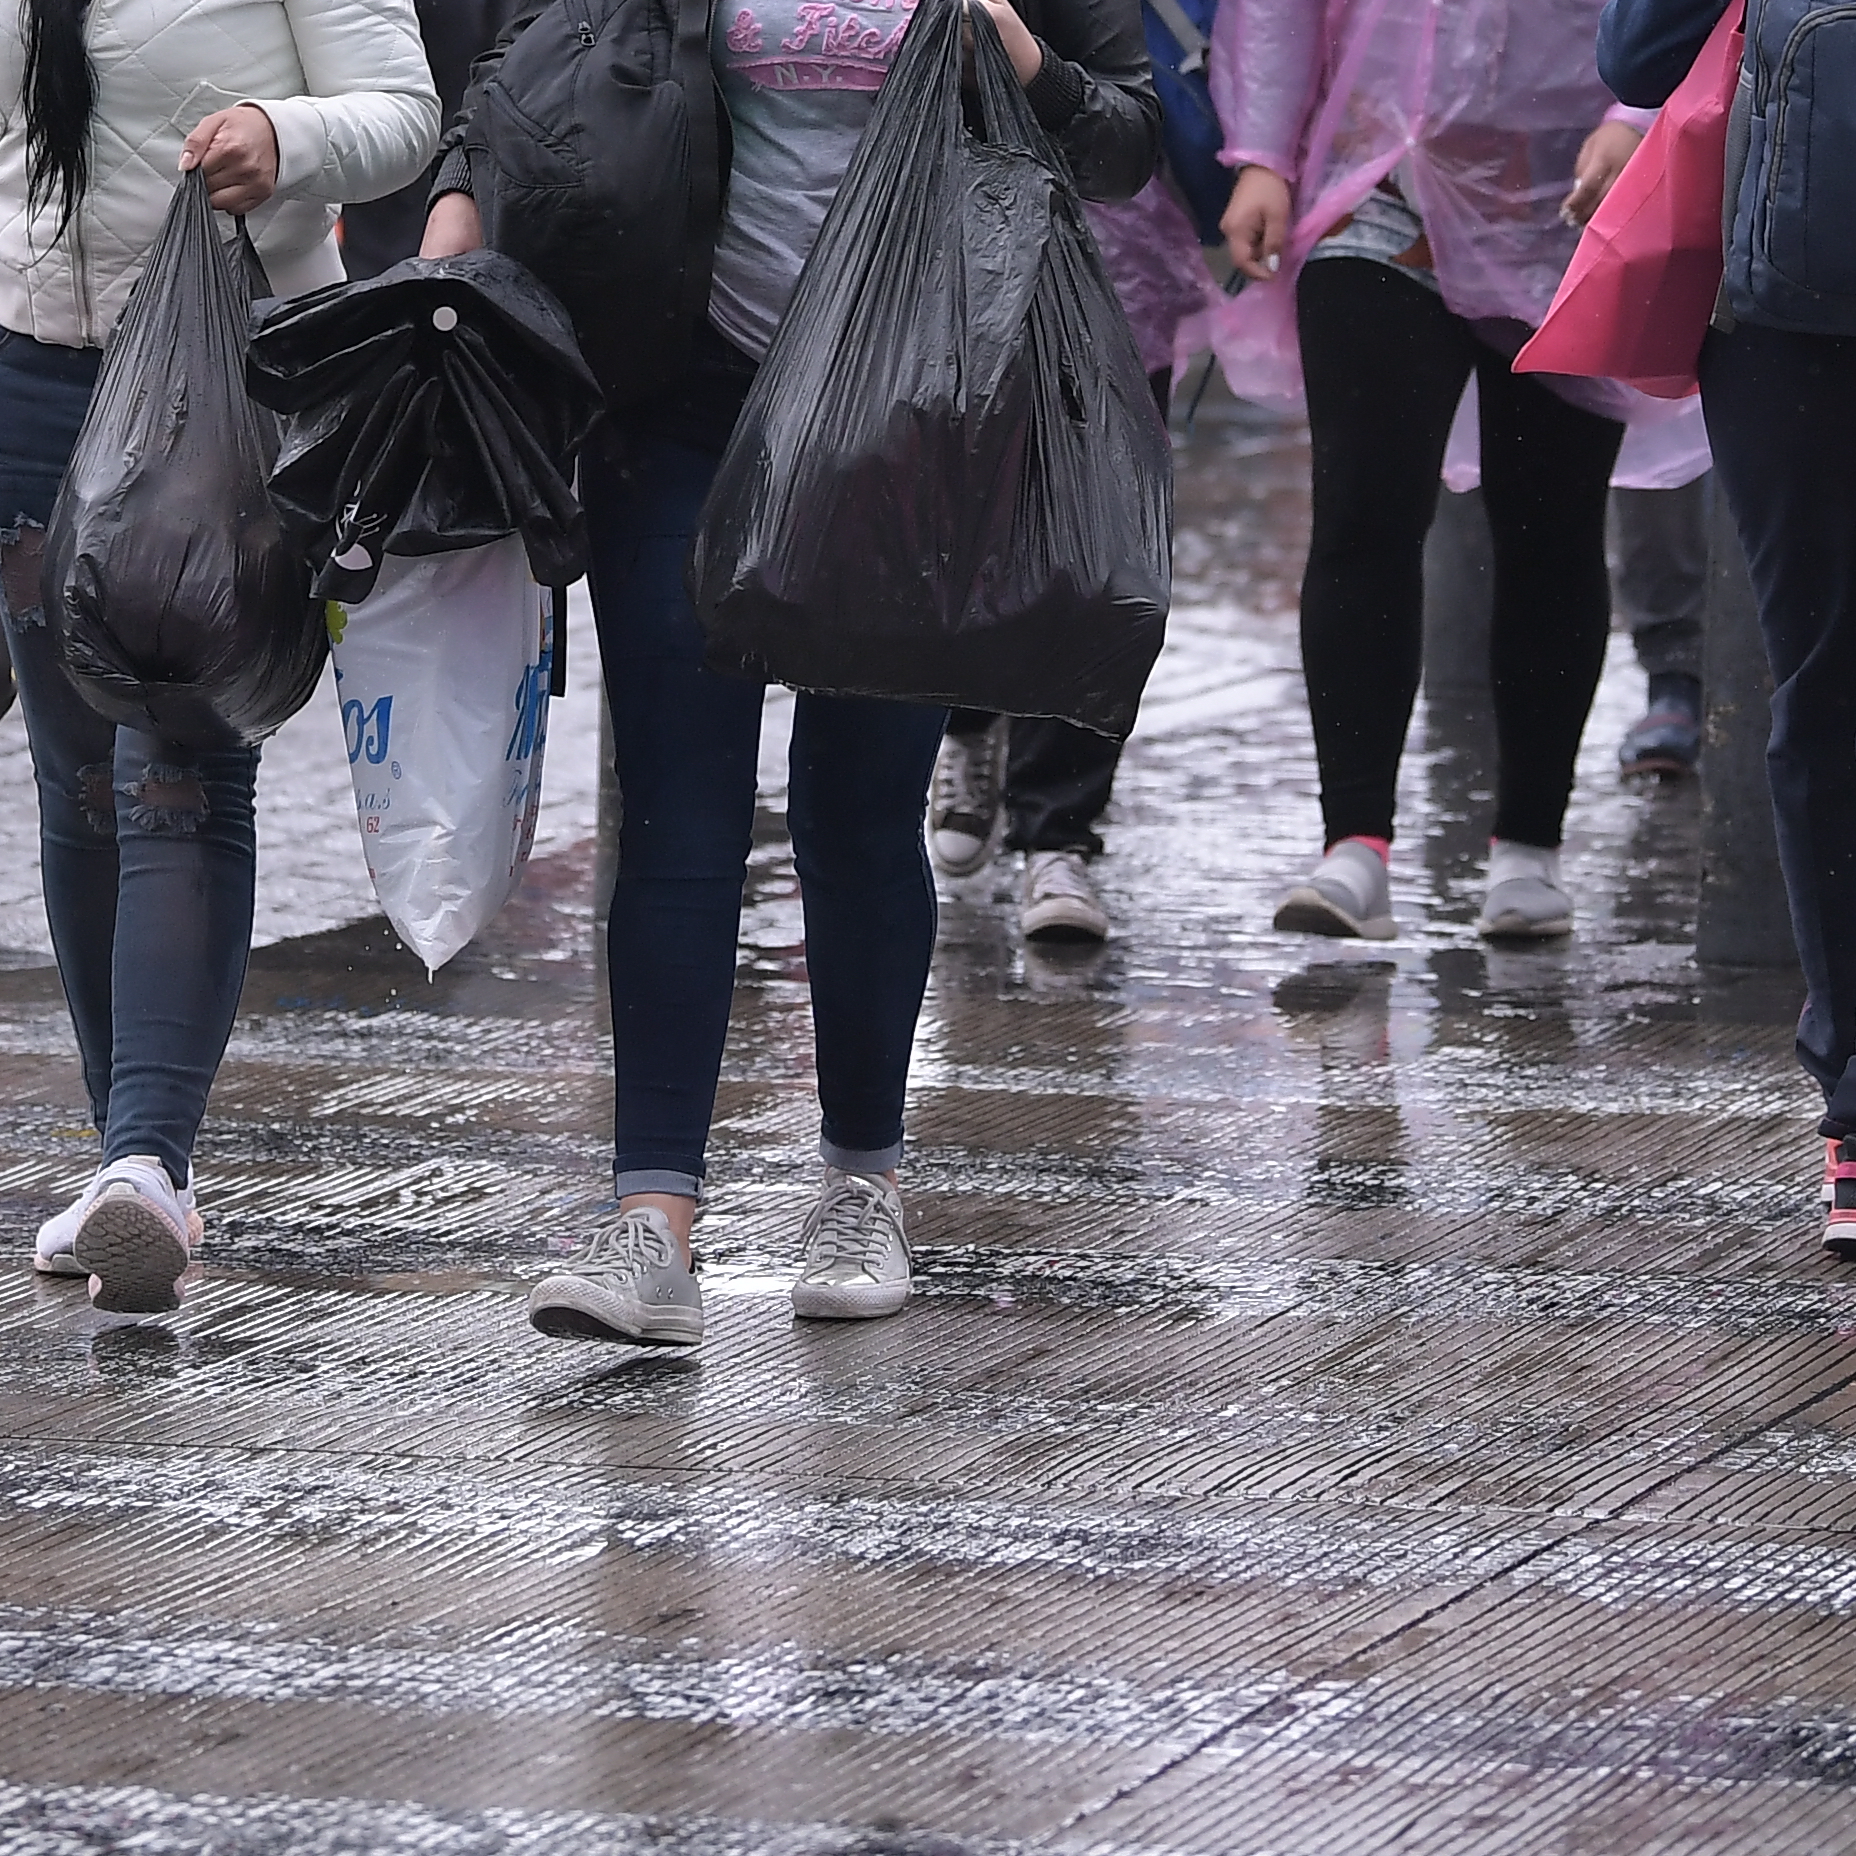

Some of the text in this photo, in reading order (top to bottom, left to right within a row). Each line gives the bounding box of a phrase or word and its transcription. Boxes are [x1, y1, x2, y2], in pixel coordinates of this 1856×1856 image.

[726, 8, 764, 53] &
[773, 63, 844, 87] N.Y.
[366, 815, 381, 834] 62
